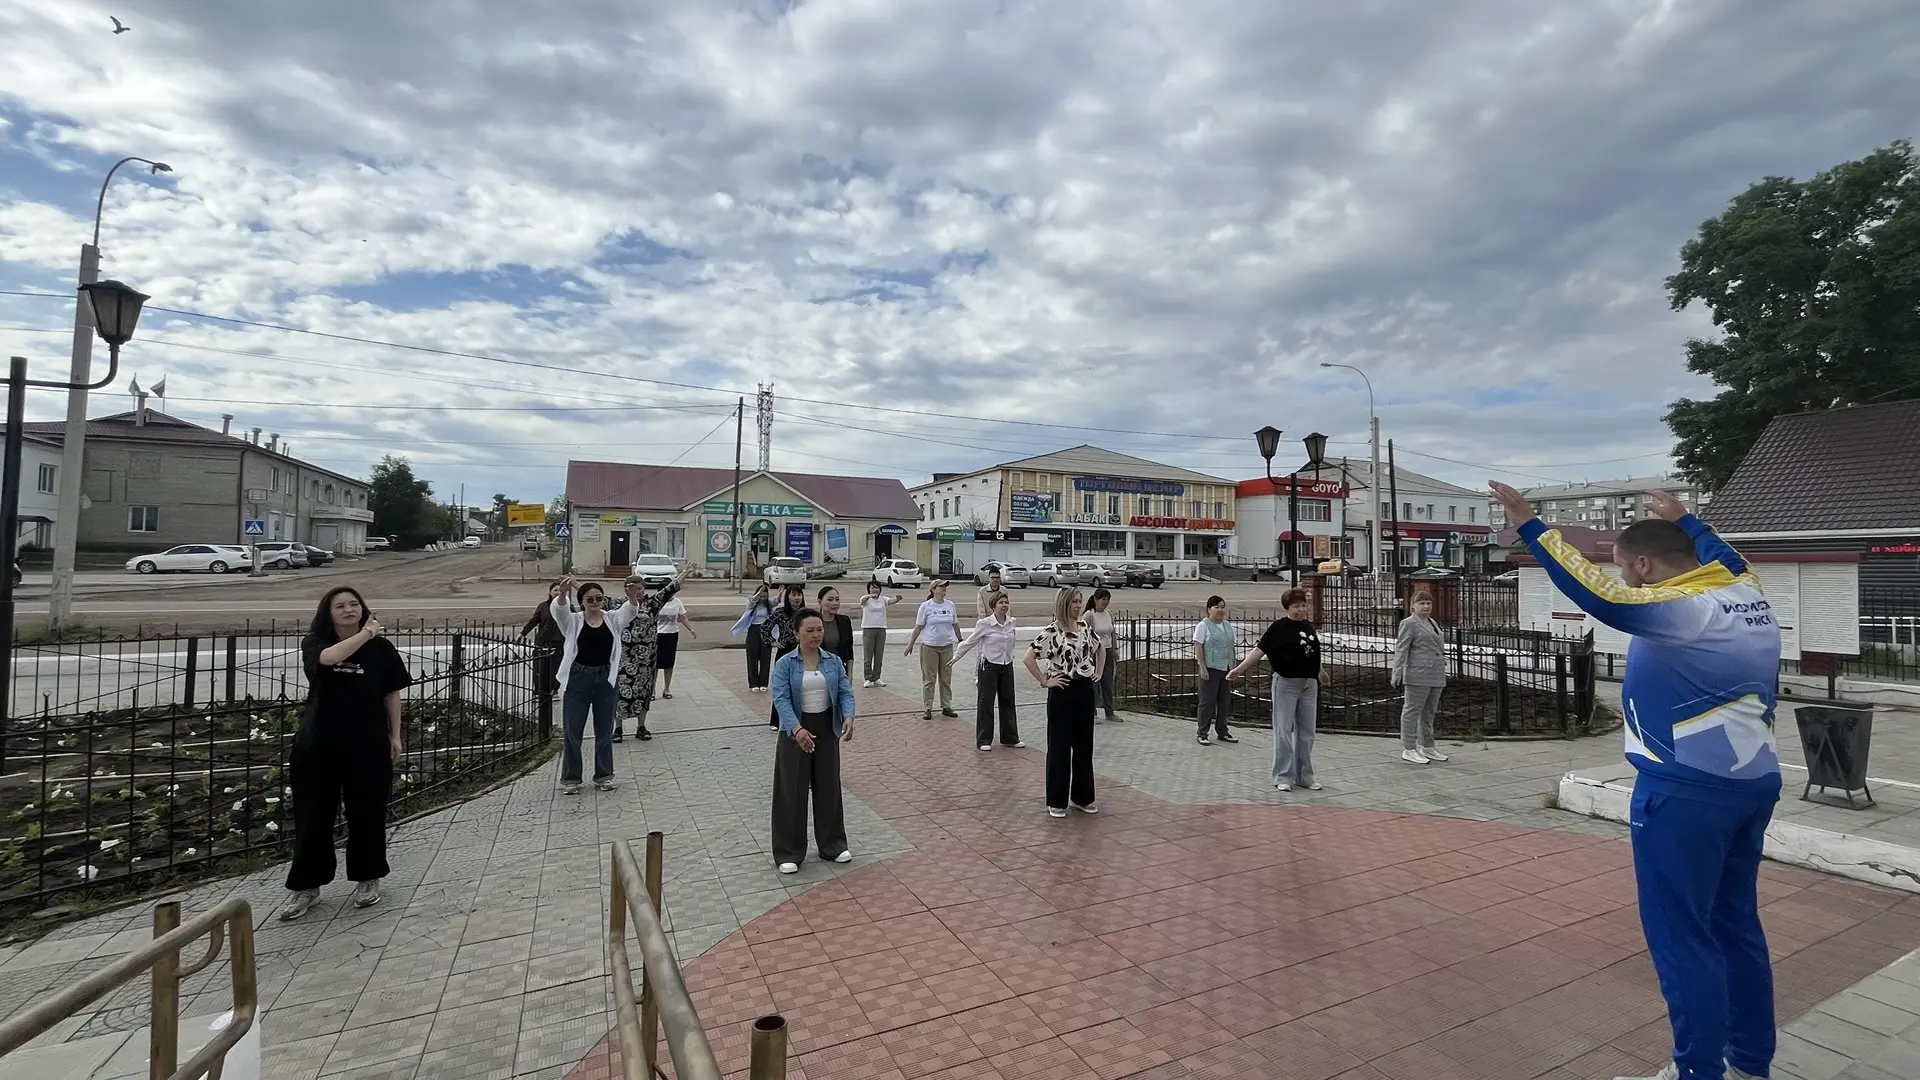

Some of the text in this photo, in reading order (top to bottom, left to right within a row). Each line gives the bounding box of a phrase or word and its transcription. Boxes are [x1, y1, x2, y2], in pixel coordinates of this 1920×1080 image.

[1312, 483, 1340, 494] GOYO
[726, 504, 792, 516] АТЕКА
[1069, 512, 1106, 524] ТАБАК
[1129, 516, 1188, 529] АБСОЛЮТ
